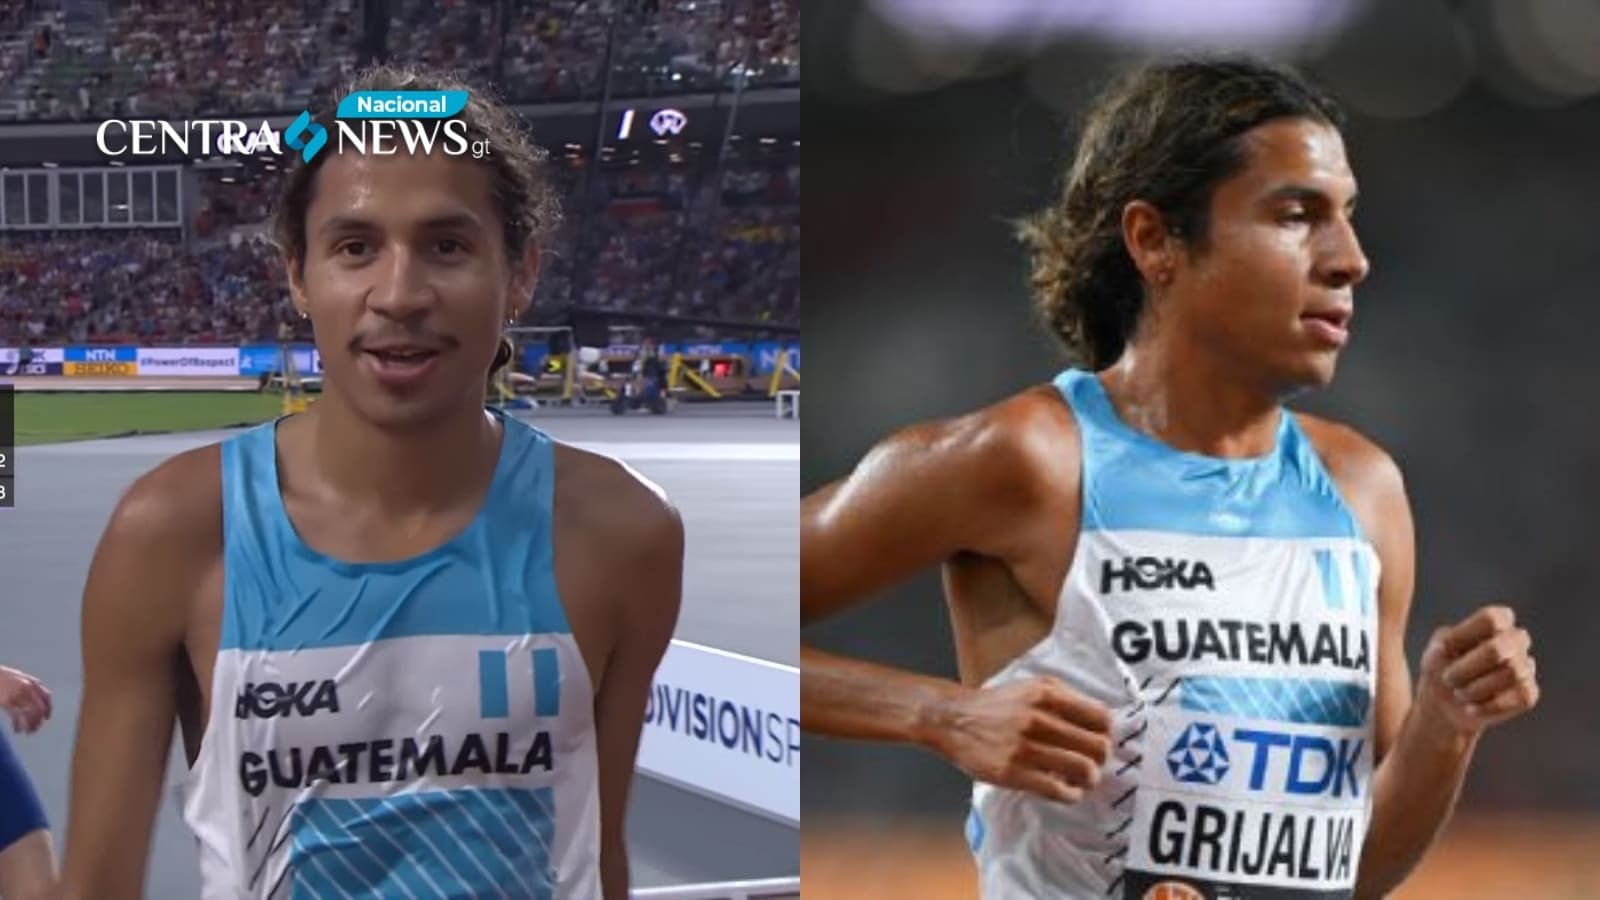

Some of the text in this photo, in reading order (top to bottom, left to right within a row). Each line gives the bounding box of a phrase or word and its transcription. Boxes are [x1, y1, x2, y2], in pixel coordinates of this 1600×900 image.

[86, 349, 116, 361] NTN
[1102, 556, 1215, 593] HOKA
[1111, 619, 1370, 672] GUATEMALA
[240, 731, 553, 797] GUATEMALA
[1232, 729, 1363, 797] TDK
[1149, 800, 1354, 880] GRIJALVA
